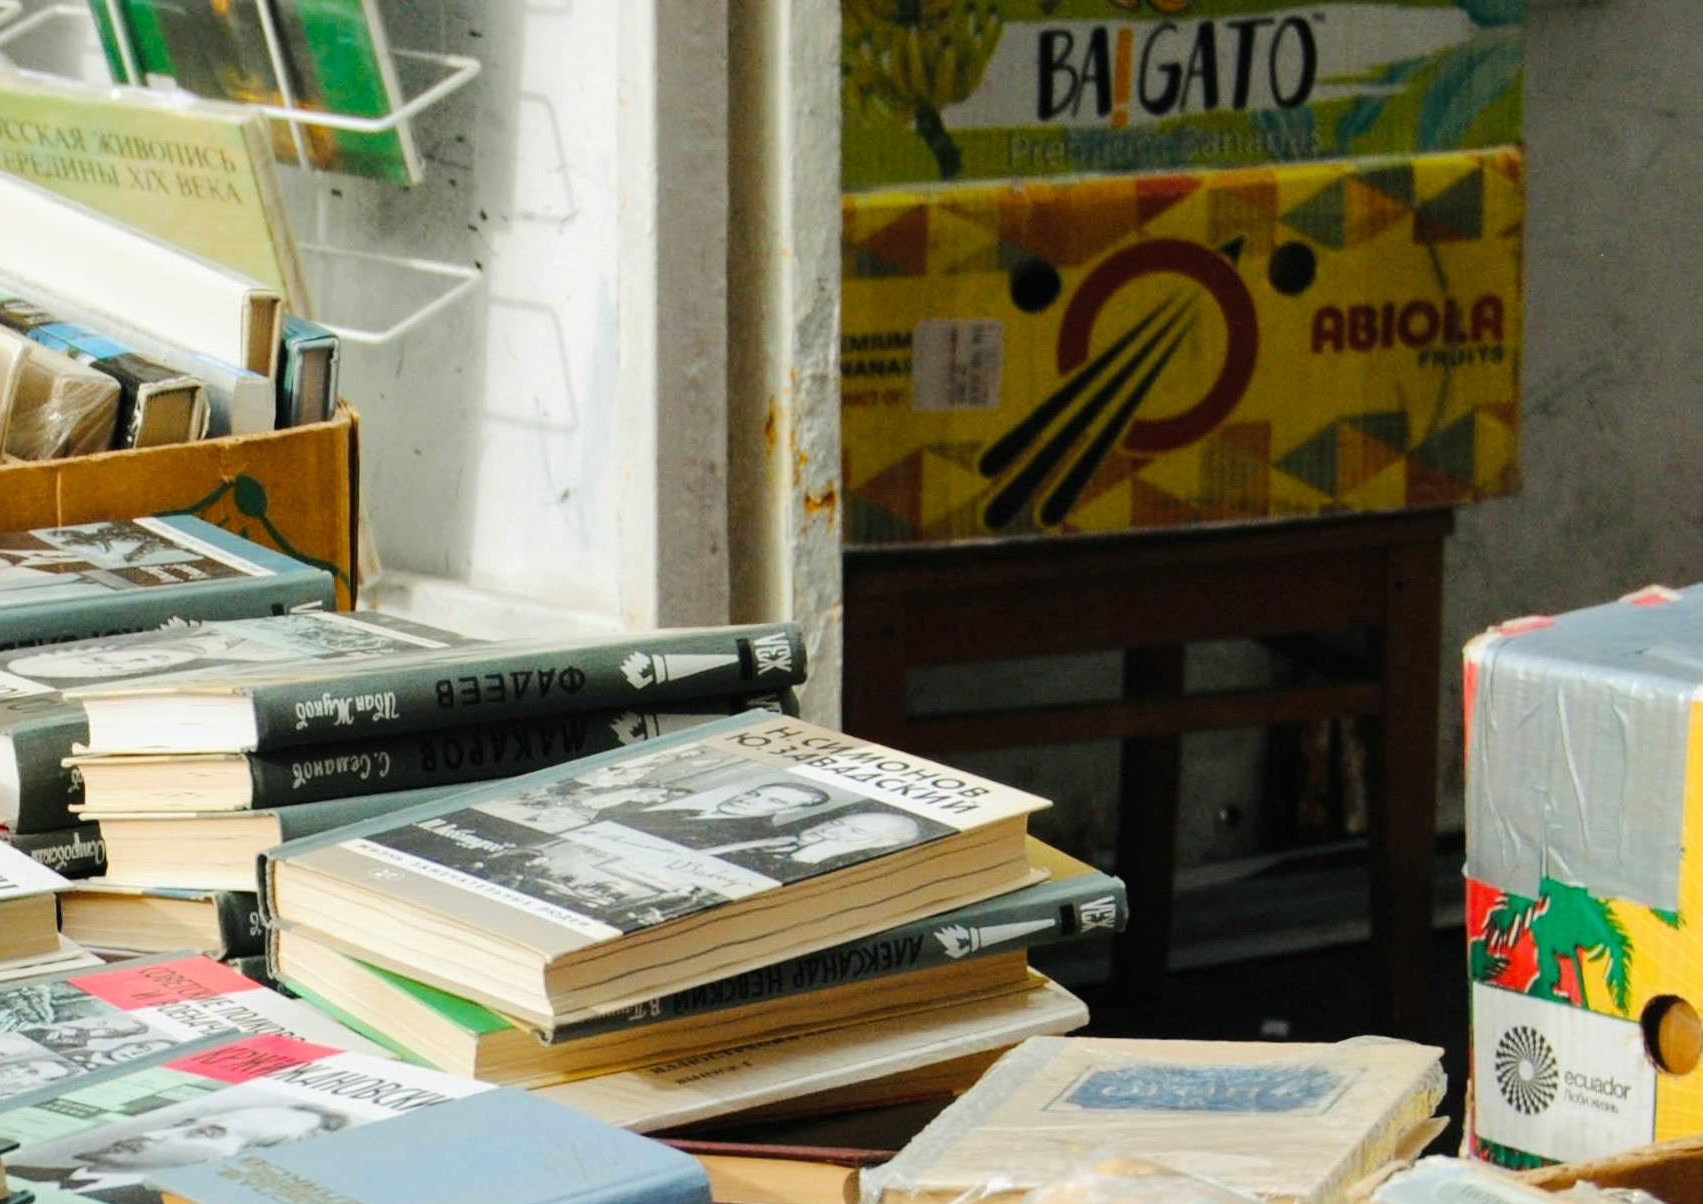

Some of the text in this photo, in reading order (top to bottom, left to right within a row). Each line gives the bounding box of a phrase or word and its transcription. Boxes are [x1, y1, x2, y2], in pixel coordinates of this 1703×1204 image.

[95, 131, 237, 172] ЖИВОПИСЬ
[177, 176, 242, 204] ВЕКА
[1310, 295, 1506, 353] ABIOLA
[295, 666, 585, 730] ФАДЕЕВ Иван Жуков
[790, 935, 924, 987] АЛЕКСАНДР
[201, 1047, 457, 1112] КРЖИЖАНОВСКИ
[1564, 1070, 1631, 1100] ecuador
